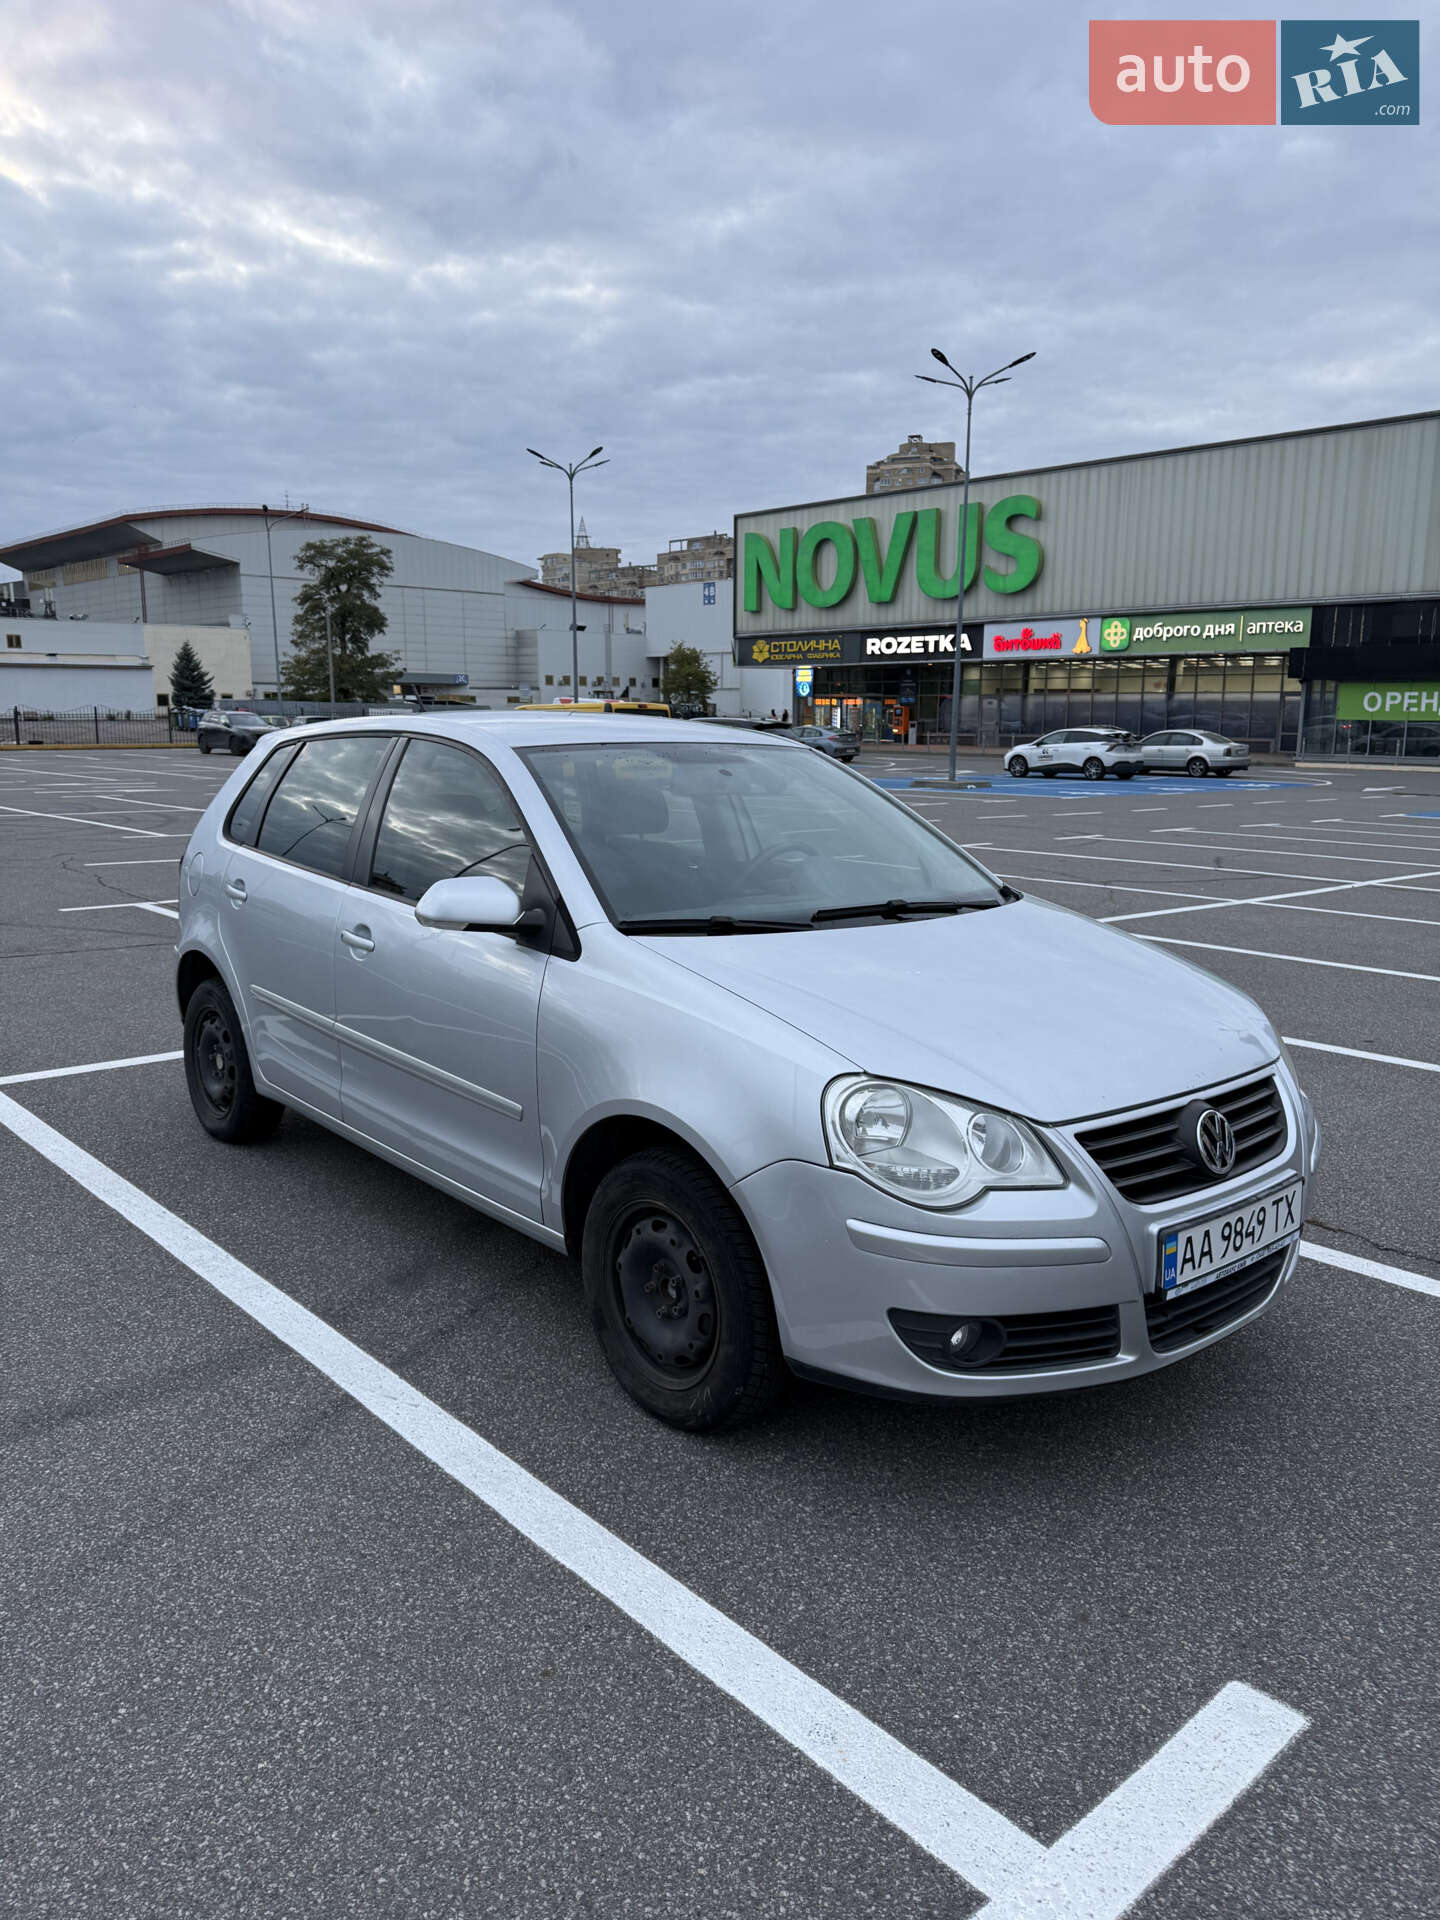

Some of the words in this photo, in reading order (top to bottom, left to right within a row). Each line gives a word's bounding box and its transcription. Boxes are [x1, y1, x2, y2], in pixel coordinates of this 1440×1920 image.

[744, 495, 1044, 612] NOVUS
[1132, 622, 1202, 642] доброго
[1203, 621, 1236, 639] дня
[1247, 620, 1304, 635] аптека
[770, 639, 841, 653] СТОЛИЧНА
[866, 634, 973, 655] ROZETKA
[1362, 690, 1440, 716] ОРЕН
[1179, 1229, 1213, 1276] AA
[1219, 1206, 1267, 1260] 9849
[1272, 1190, 1297, 1233] TX
[1164, 1268, 1176, 1281] UA
